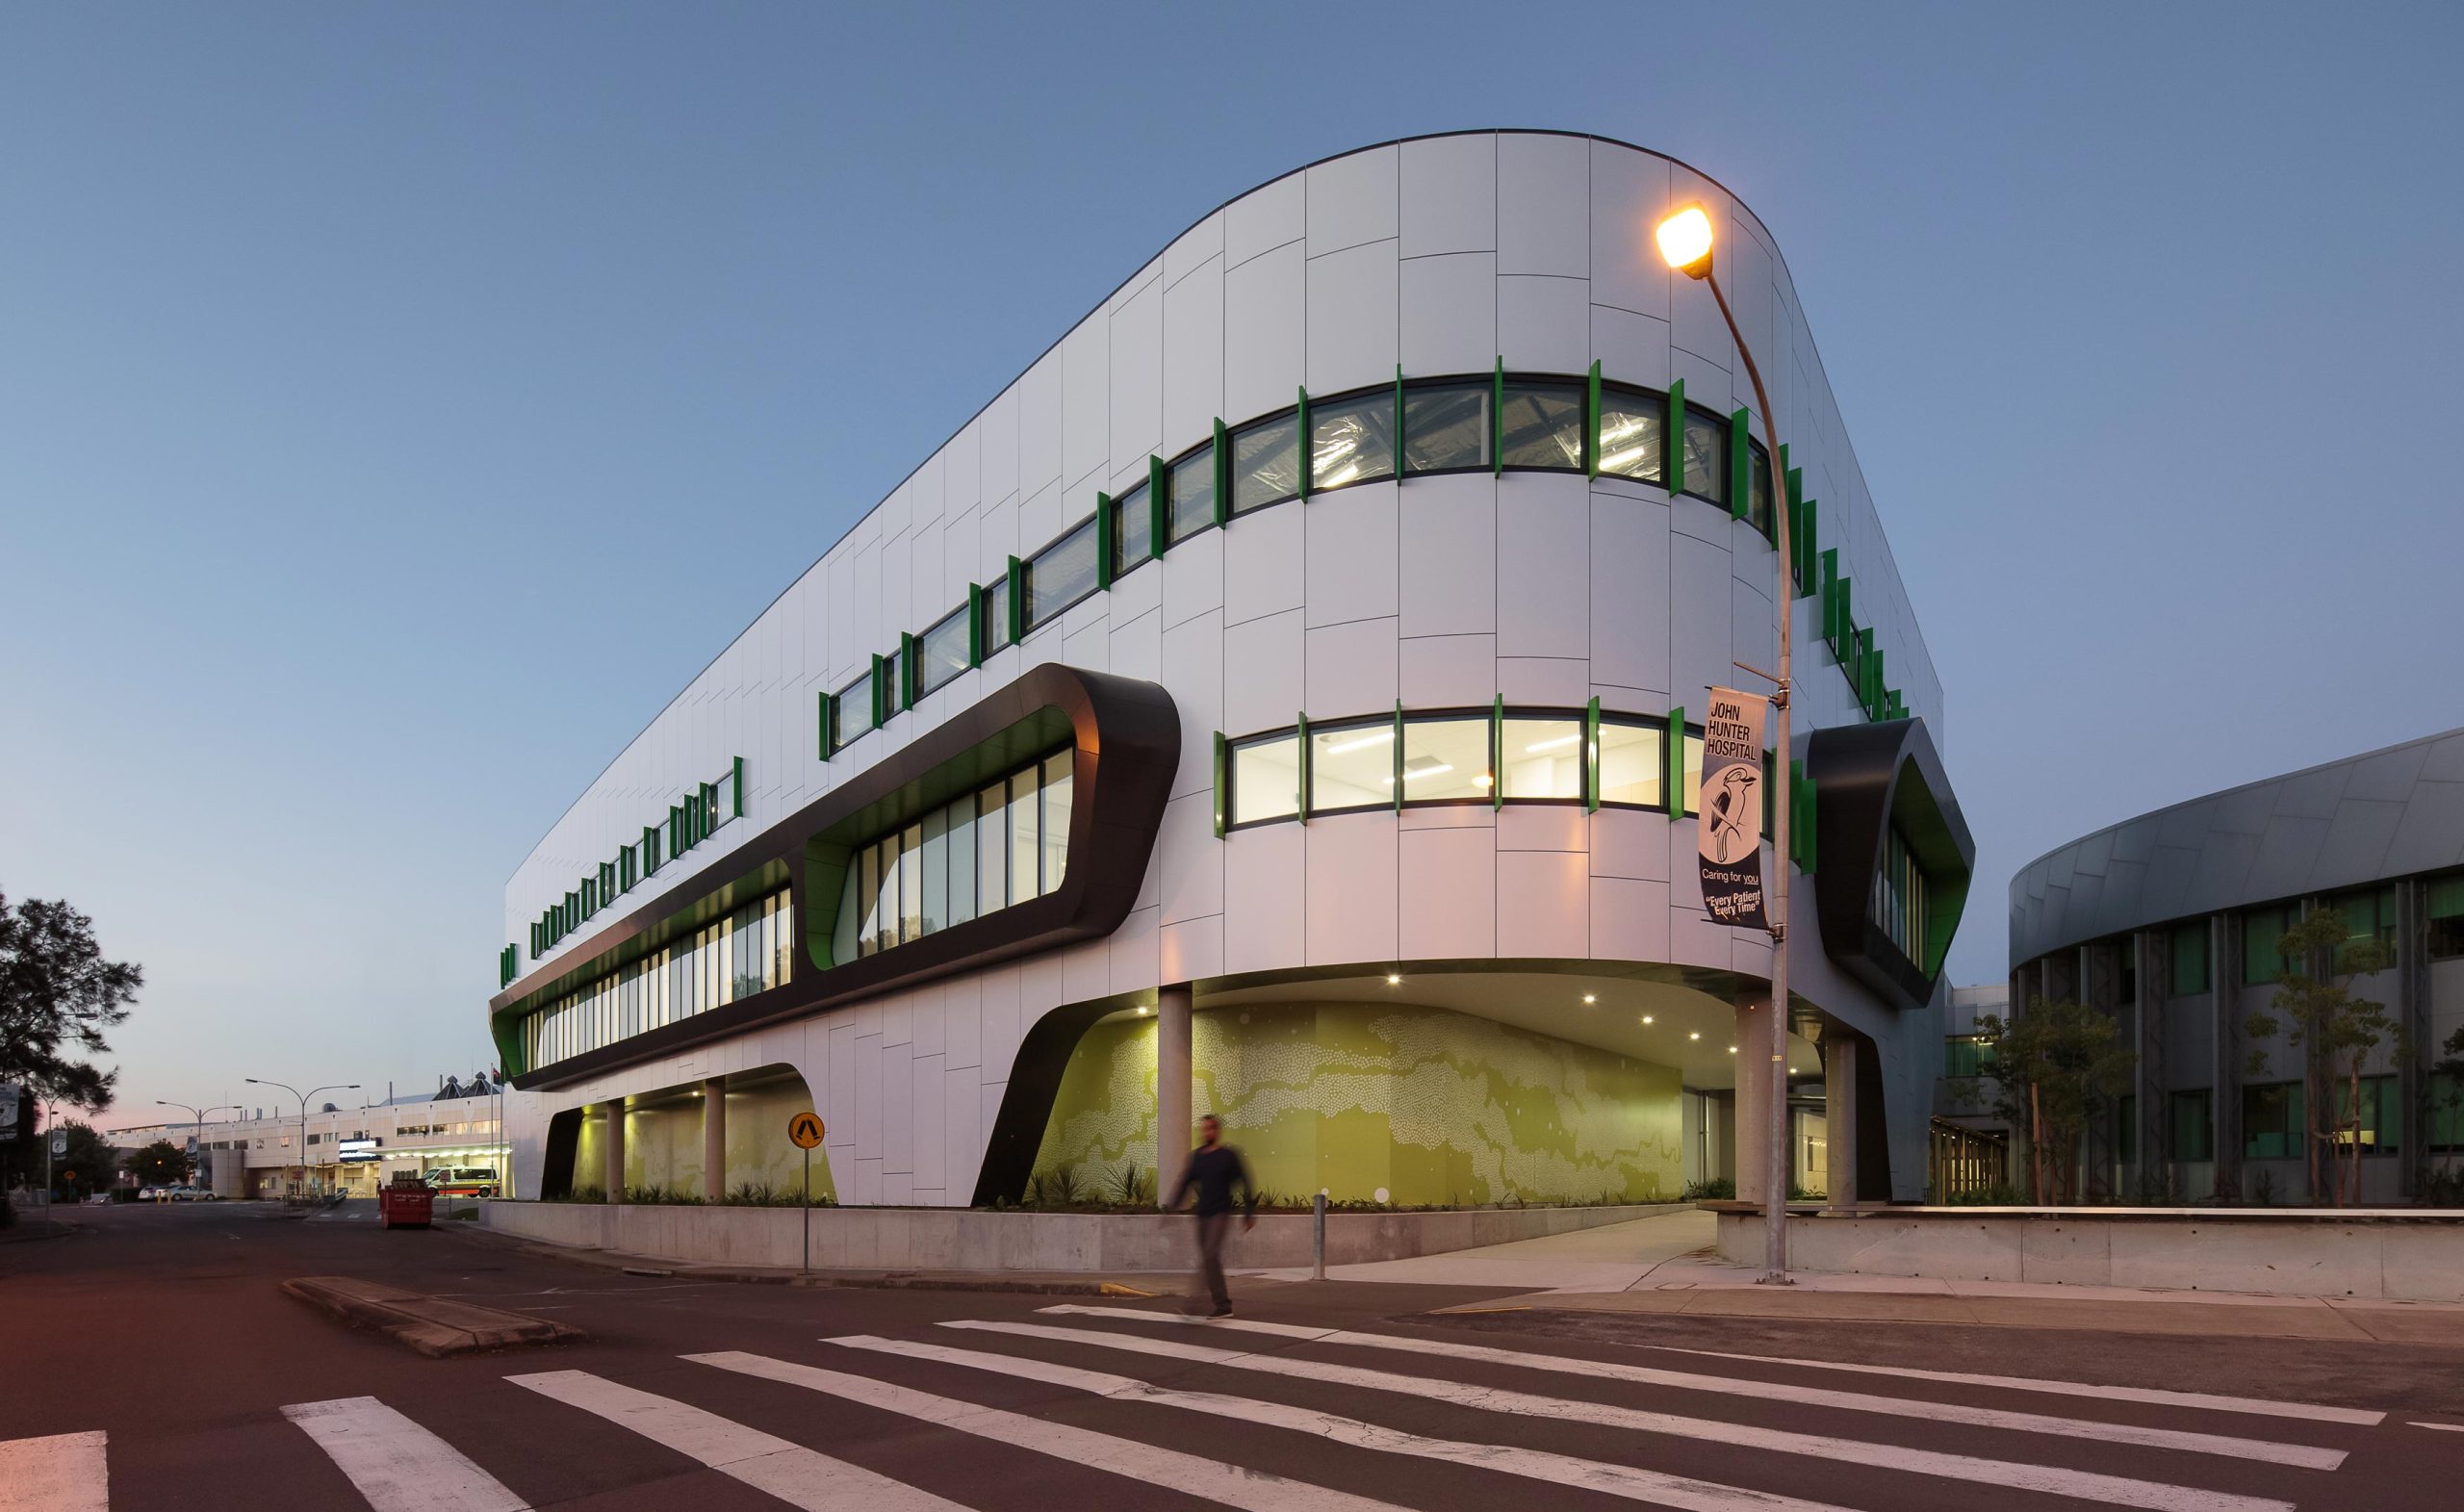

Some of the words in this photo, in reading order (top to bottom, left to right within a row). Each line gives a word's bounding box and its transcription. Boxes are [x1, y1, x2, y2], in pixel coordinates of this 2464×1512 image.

[1711, 702, 1740, 721] JOHN
[1708, 720, 1750, 741] HUNTER
[1707, 738, 1757, 760] HOSPITAL
[1702, 868, 1729, 883] Caring
[1730, 871, 1741, 882] for
[1743, 875, 1758, 884] you
[1732, 890, 1760, 904] Patient
[1714, 905, 1736, 916] Every
